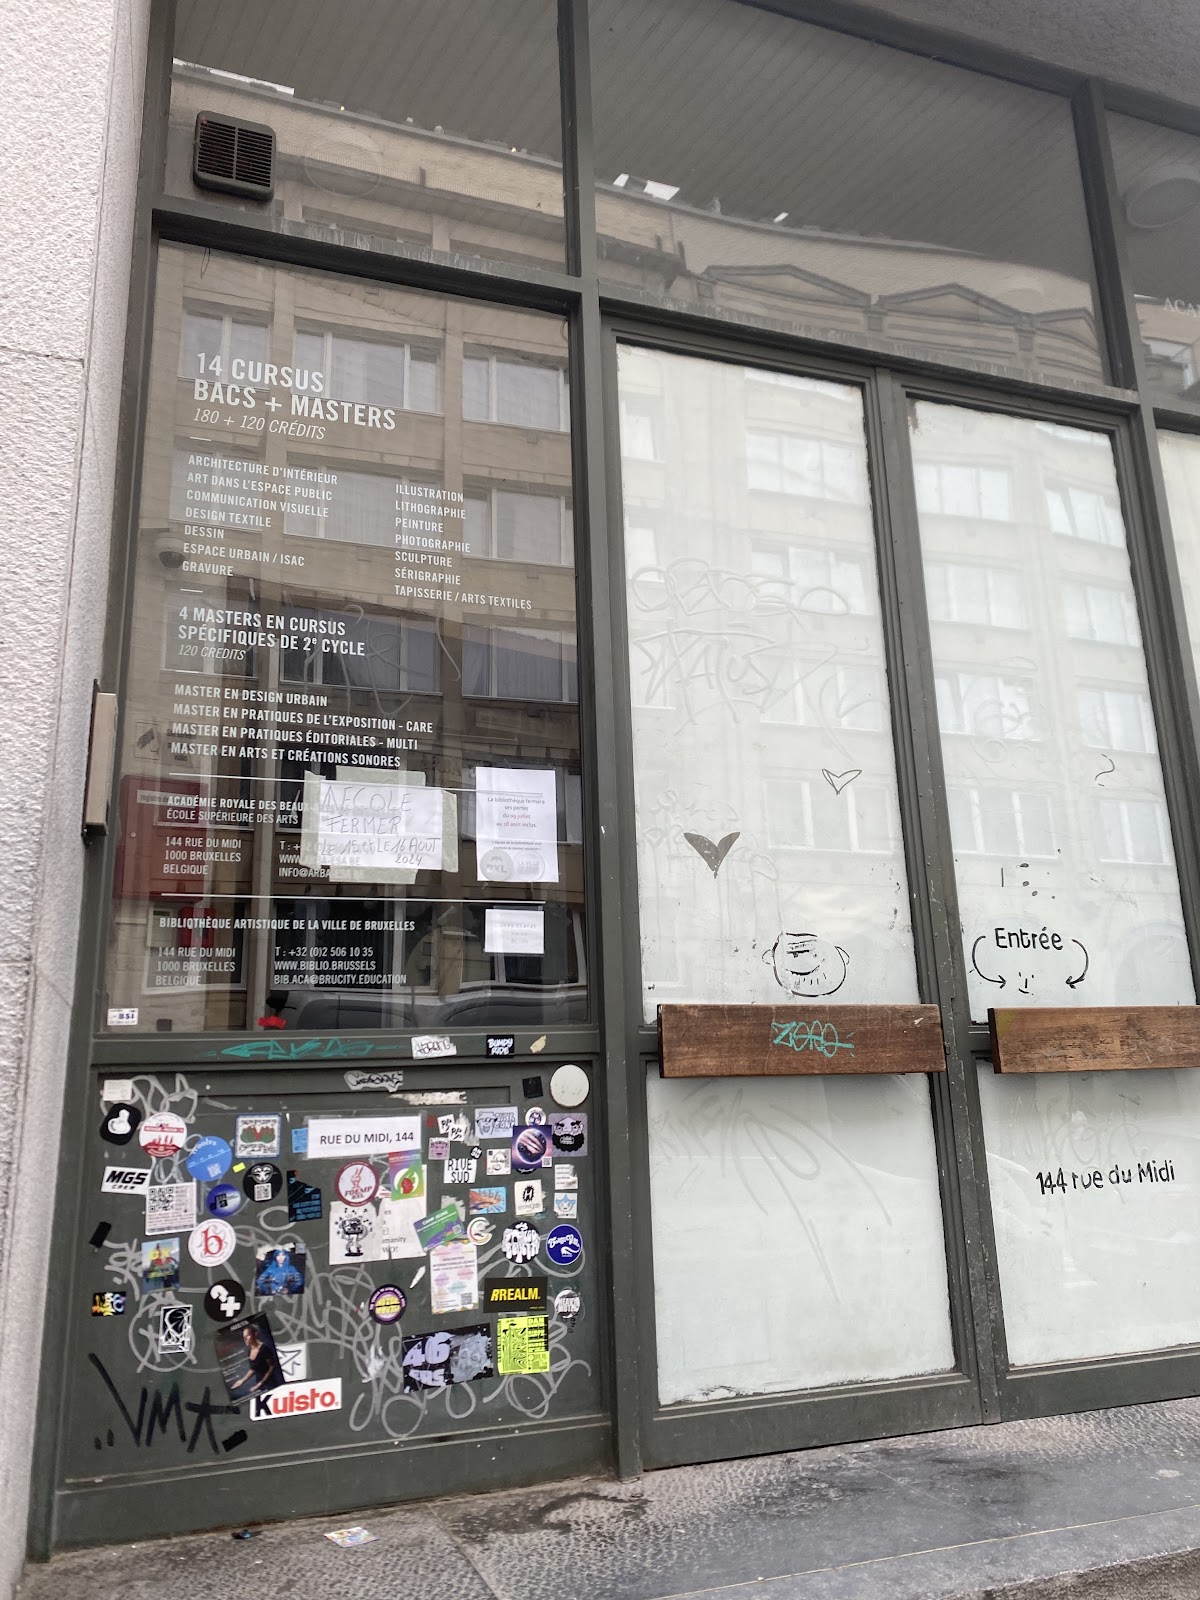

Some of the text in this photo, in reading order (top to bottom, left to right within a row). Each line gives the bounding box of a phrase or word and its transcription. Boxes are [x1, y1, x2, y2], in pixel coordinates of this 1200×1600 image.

[197, 352, 324, 393] 14 CURSUS
[194, 378, 396, 430] BACS + MASTERS
[193, 408, 326, 440] 180 + 120 CRÉDITS
[188, 454, 269, 475] ARCHITECTURE
[187, 472, 333, 501] ART DANS L'ESPACE PUBLIC
[396, 484, 464, 503] ILLUSTRATION
[186, 489, 329, 517] COMMUNICATION VISUELLE
[395, 500, 467, 519] LITHOGRAPHIE
[185, 507, 272, 527] DESIGN TEXTILE
[395, 517, 444, 533] PEINTURE
[184, 524, 225, 539] DESSIN
[395, 534, 471, 553] PHOTOGRAPHIE
[183, 542, 305, 567] ESPACE URBAIN / ISAC
[395, 551, 453, 567] SCULPTURE
[182, 560, 234, 577] GRAVURE
[394, 567, 461, 585] SÉRIGRAPHIE
[394, 585, 532, 610] TAPISSERIE / ARTS TEXTILES
[179, 606, 346, 636] 4 MASTERS EN CURSUS
[178, 624, 276, 648] SPÉCIFIQUES
[281, 635, 299, 650] DE
[321, 638, 366, 656] CYCLE
[178, 644, 198, 656] 120
[174, 684, 328, 706] MASTER EN DESIGN URBAIN
[173, 703, 220, 717] MASTER
[223, 707, 238, 719] EN
[241, 708, 304, 724] PRATIQUES
[306, 713, 320, 725] DE
[323, 714, 396, 730] L'EXPOSITION
[406, 720, 433, 733] CARE
[172, 722, 219, 737] MASTER
[222, 726, 237, 738] EN
[240, 727, 303, 742] PRATIQUES
[306, 730, 376, 747] ÉDITORIALES
[386, 737, 418, 750] MULTI
[171, 742, 401, 767] MASTER EN ARTS ET CRÉATIONS SONORES
[167, 795, 217, 808] ACADÉMIE
[220, 798, 256, 810] ROYALE
[258, 800, 276, 811] DES
[166, 809, 299, 825] ÉCOLE SUPÉRIEURE DES ARTS
[326, 815, 401, 836] FERMER
[165, 836, 242, 849] 144 RUE DU MIDI
[279, 841, 285, 850] T
[164, 850, 242, 862] 1000 BRUXELLES
[395, 853, 422, 866] 2024
[163, 864, 209, 875] BELGIQUE
[159, 916, 416, 931] BIBLIOTHÈQUE ARTISTIQUE DE LA VILLE DE BRUXELLES
[994, 926, 1064, 951] Entrée
[158, 946, 236, 958] 144 RUE DU MIDI
[274, 946, 281, 957] T
[288, 946, 307, 957] +32
[309, 946, 328, 958] (0)2
[330, 946, 347, 957] 506
[349, 946, 360, 957] 10
[362, 946, 374, 957] 35
[157, 961, 236, 972] 1000 BRUXELLES
[274, 960, 376, 971] WWW.BIBLIO.BRUSSELS
[155, 975, 201, 986] BELGIQUE
[273, 974, 407, 985] BIB.ACA@BRUCITY.EDUCATION
[320, 1132, 414, 1145] RUE DU MIDI, 144
[448, 1158, 472, 1171] RIVE
[105, 1170, 149, 1185] MGS
[451, 1171, 470, 1183] SUD
[1036, 1159, 1176, 1195] 144 rue du Midi
[254, 1388, 336, 1418] Kuisto
